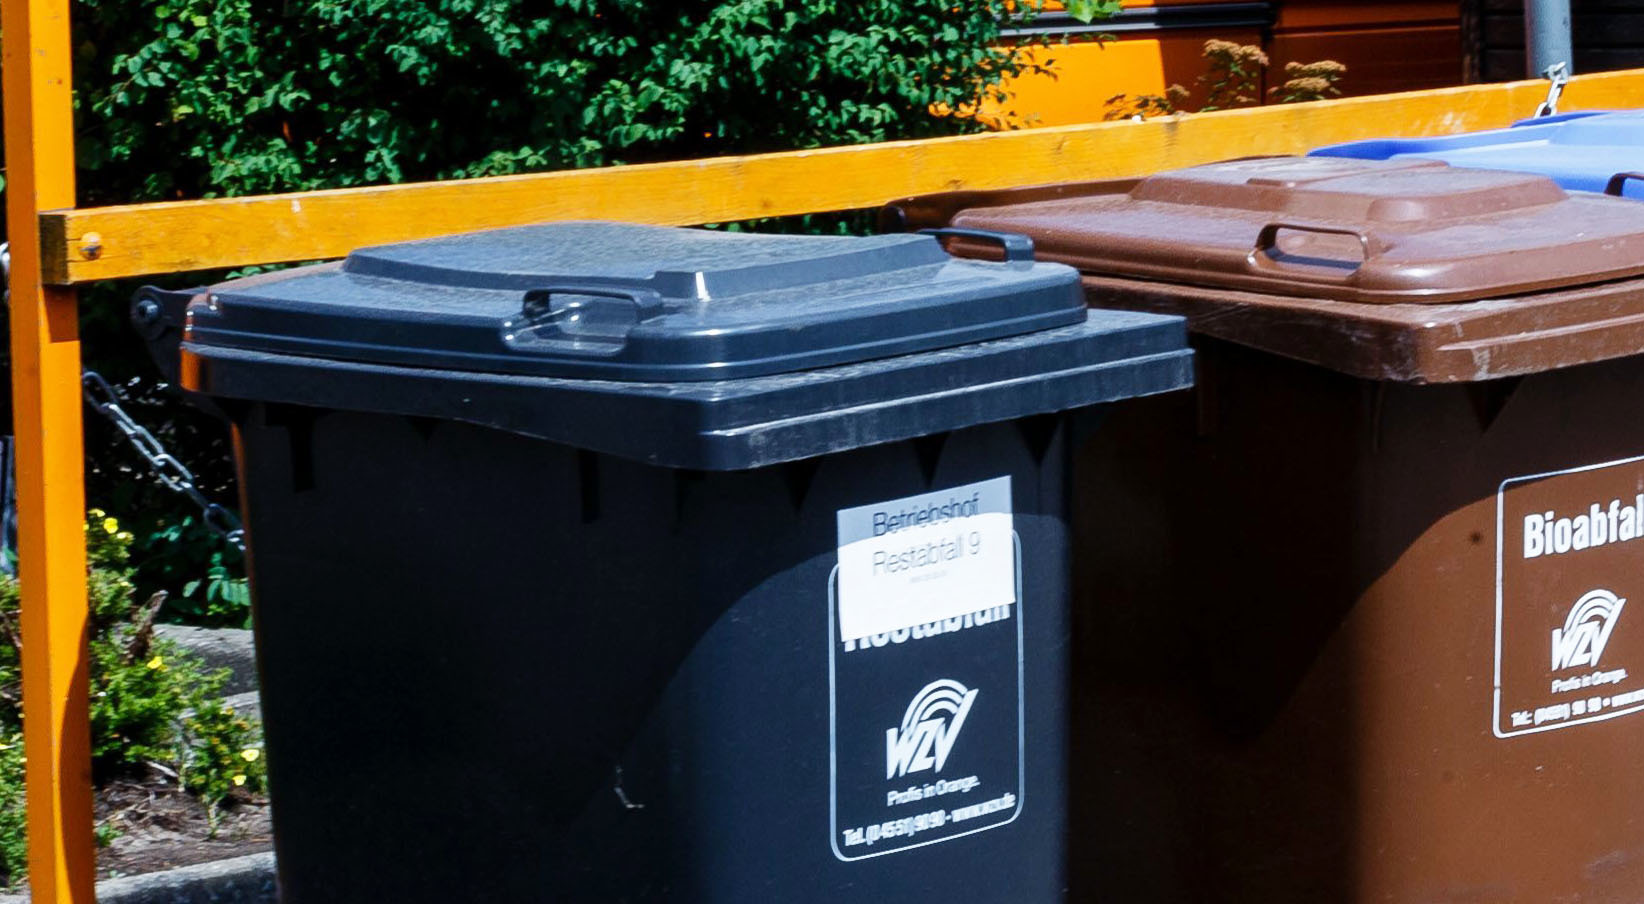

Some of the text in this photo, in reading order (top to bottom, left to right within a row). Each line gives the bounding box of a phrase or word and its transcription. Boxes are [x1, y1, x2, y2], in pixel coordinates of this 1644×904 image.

[872, 493, 981, 537] Betriebshof
[872, 530, 982, 577] Restabfall 9
[886, 688, 979, 780] WZV
[888, 787, 923, 806] Profis
